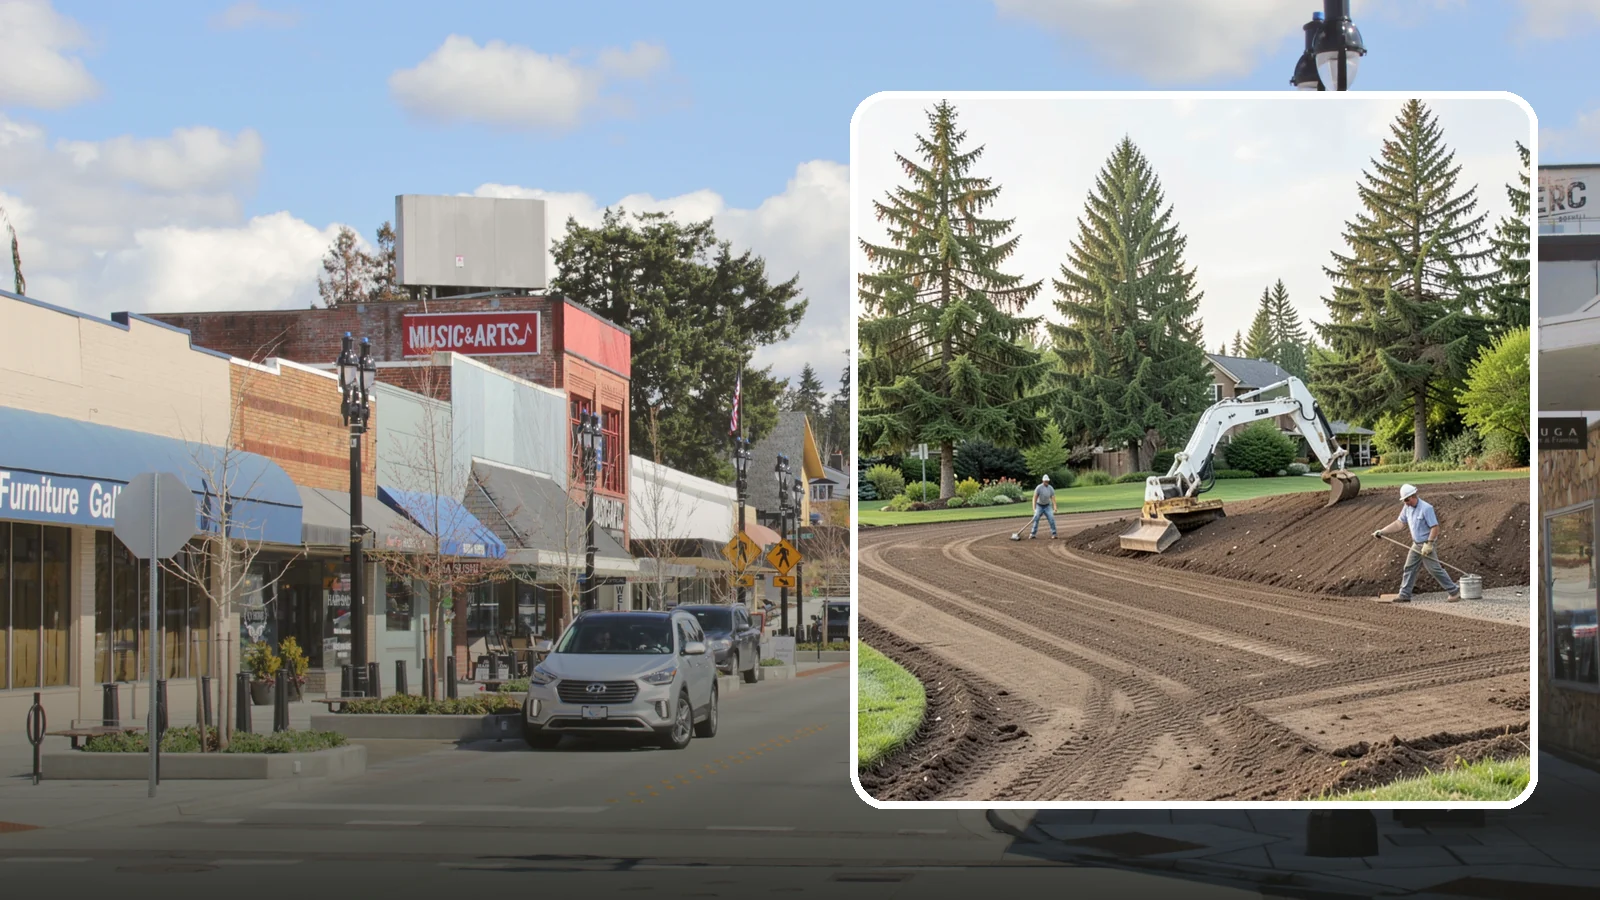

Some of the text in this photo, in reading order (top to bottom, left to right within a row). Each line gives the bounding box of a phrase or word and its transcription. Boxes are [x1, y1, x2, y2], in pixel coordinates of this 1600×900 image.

[0, 471, 122, 519] Furniture Gal
[453, 563, 479, 574] SUSHI
